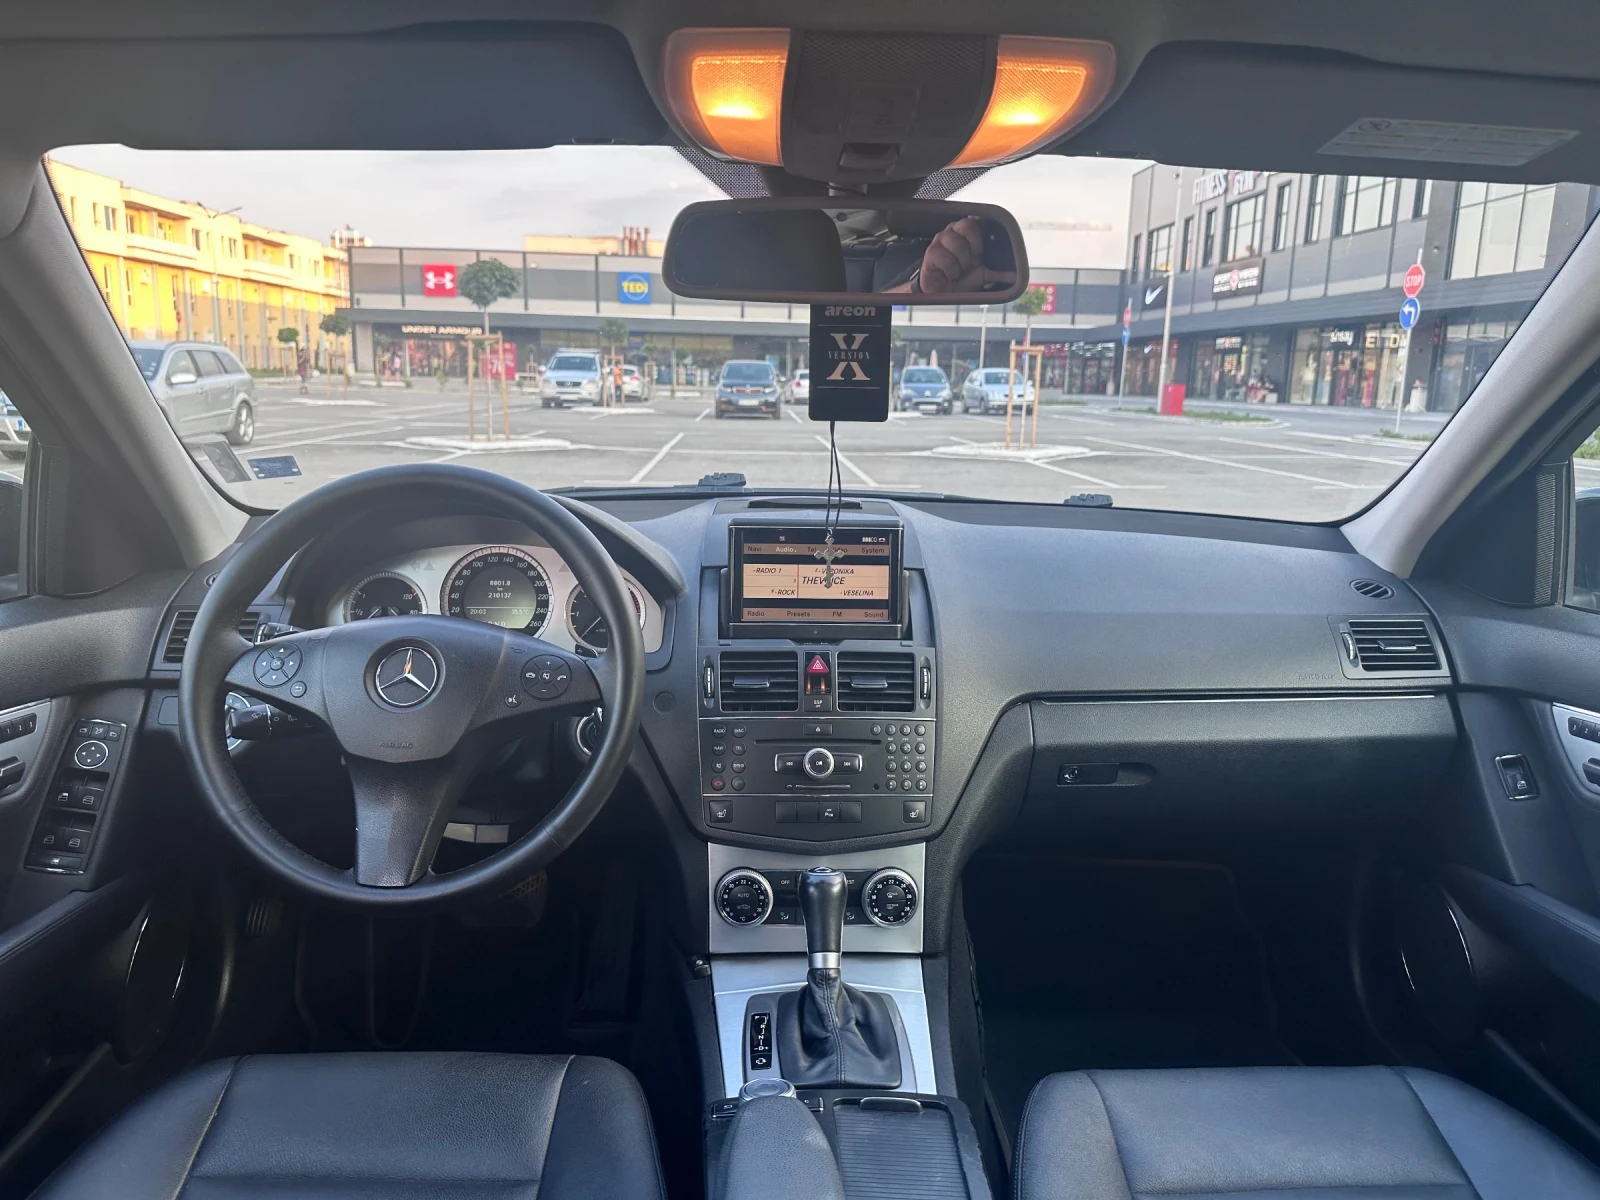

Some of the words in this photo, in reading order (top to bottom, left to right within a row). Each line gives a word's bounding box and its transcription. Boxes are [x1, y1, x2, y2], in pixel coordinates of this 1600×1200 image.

[1192, 170, 1228, 206] FITNESS
[1405, 275, 1422, 288] STOP
[824, 306, 876, 317] areon
[401, 325, 437, 334] UNDER
[438, 325, 483, 336] ARMOUR
[826, 333, 871, 381] X
[828, 351, 871, 360] VERSION
[802, 576, 846, 585] THEVICE
[379, 741, 414, 749] AIRBAG
